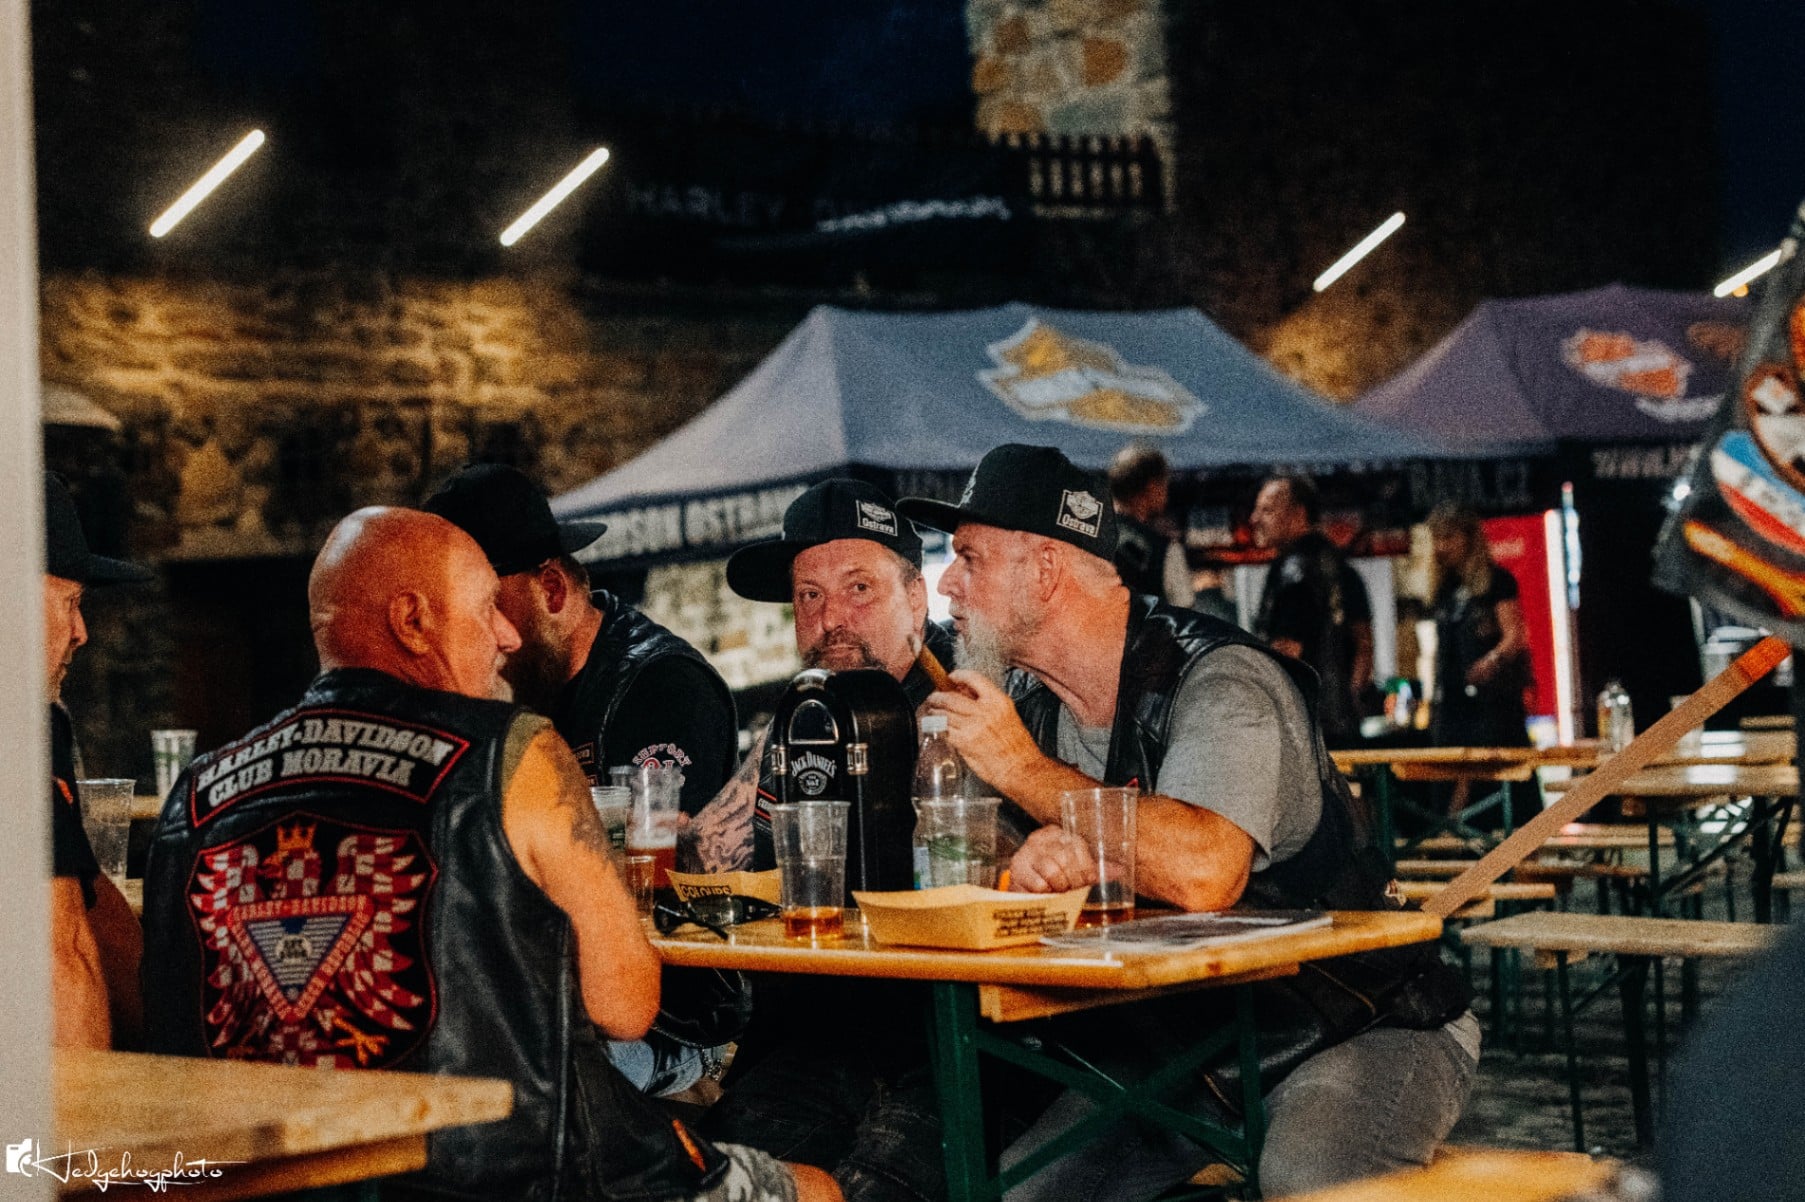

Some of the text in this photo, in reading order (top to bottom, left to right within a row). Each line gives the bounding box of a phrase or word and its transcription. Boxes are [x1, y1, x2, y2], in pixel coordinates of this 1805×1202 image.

[862, 516, 895, 534] Ostrava
[1061, 514, 1096, 535] Ostrava
[197, 718, 454, 793] HARLEY-DAVIDSON
[632, 743, 693, 767] SUPPORT
[791, 754, 807, 778] JACK
[208, 747, 416, 807] CLUB MORAVIA
